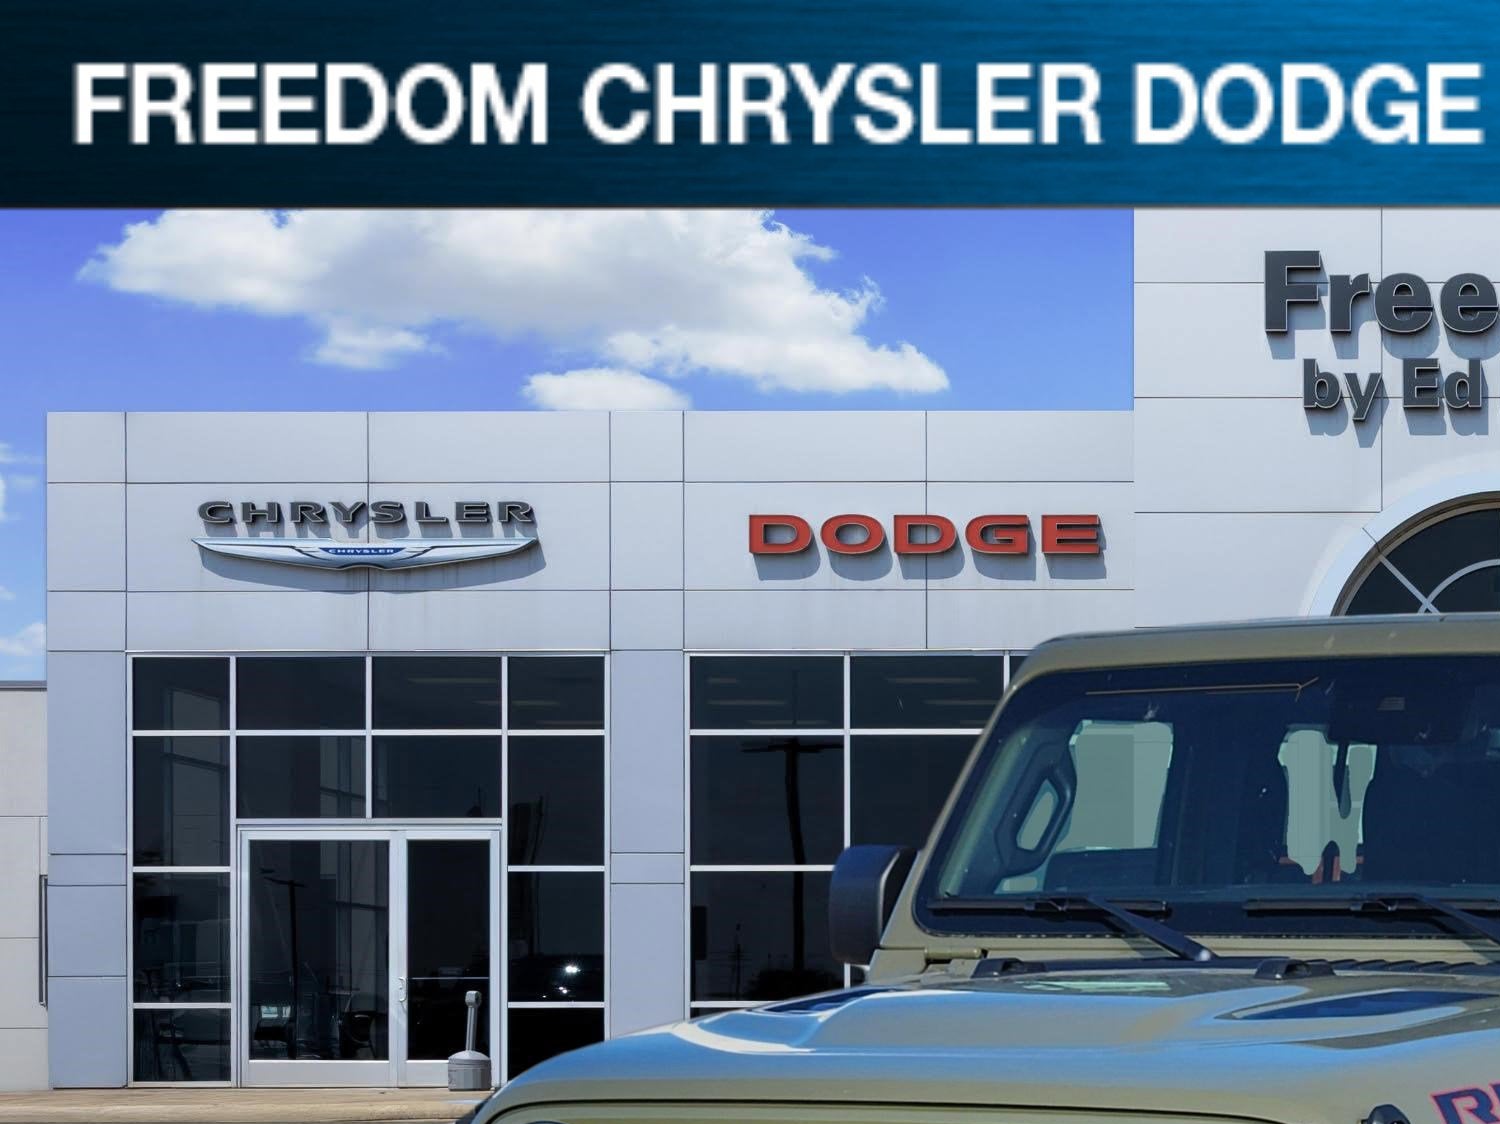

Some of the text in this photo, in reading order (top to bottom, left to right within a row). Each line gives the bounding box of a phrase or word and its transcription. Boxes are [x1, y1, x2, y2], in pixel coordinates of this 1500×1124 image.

[1302, 359, 1382, 421] by
[1403, 359, 1482, 409] Ed
[197, 500, 536, 526] CHRYSLER
[748, 513, 1104, 557] DODGE
